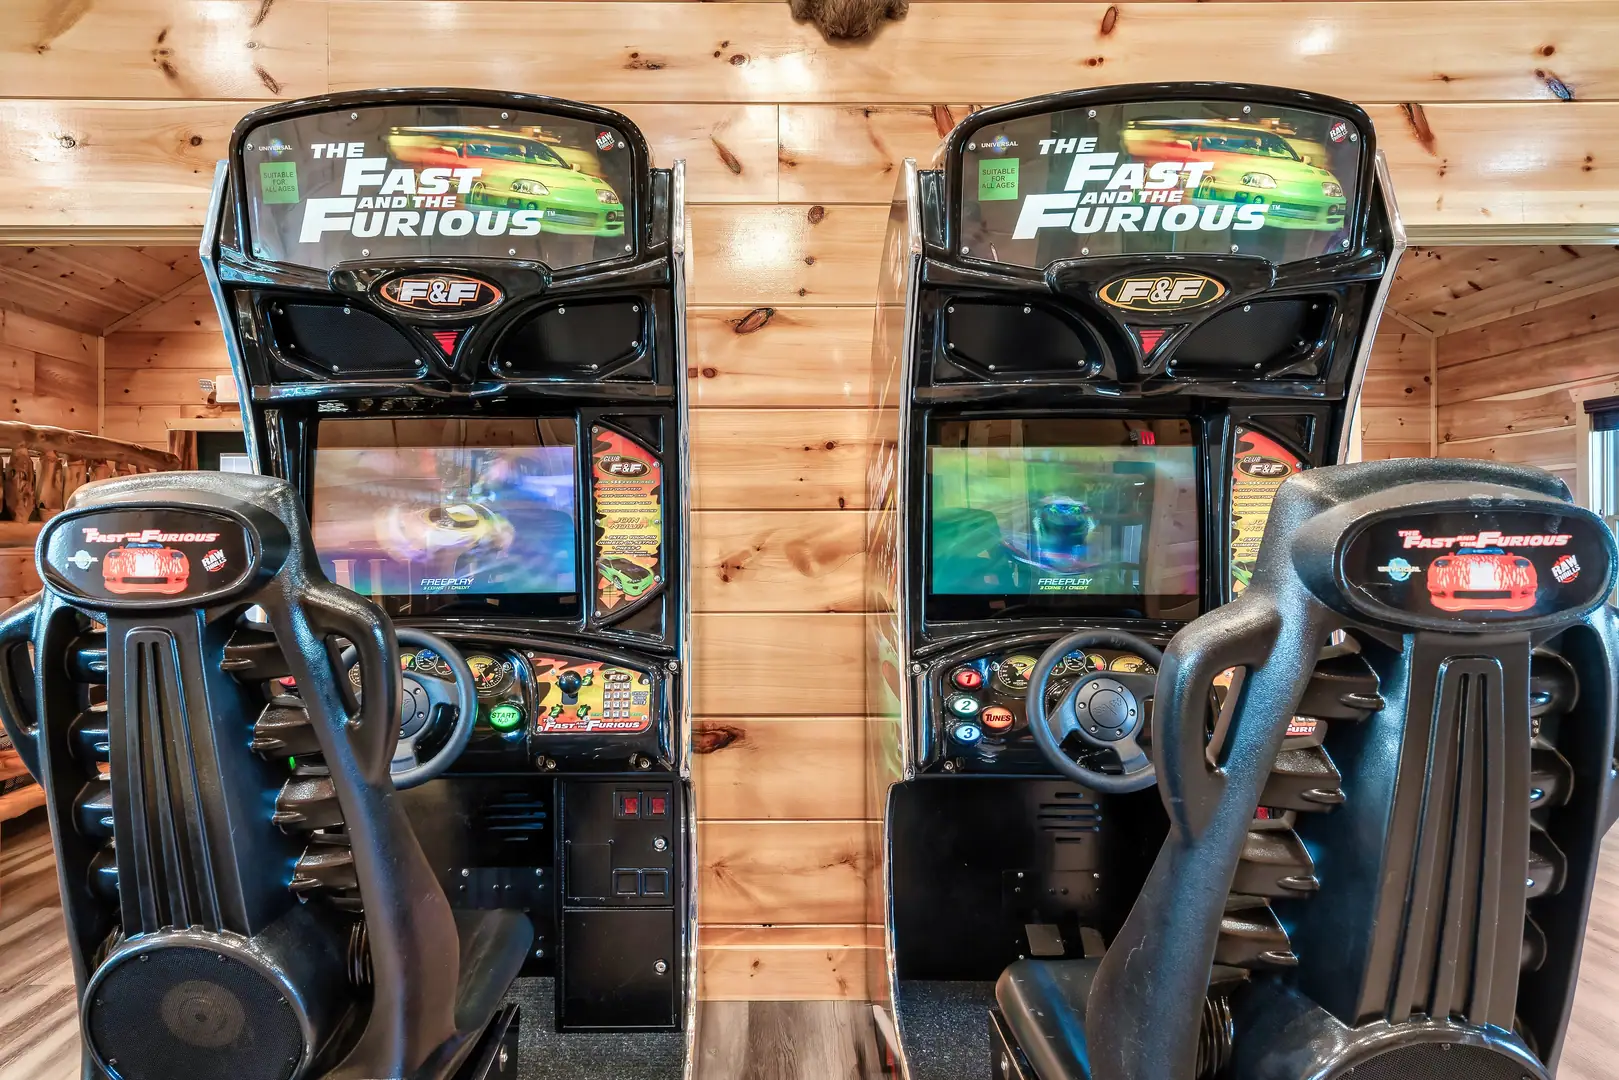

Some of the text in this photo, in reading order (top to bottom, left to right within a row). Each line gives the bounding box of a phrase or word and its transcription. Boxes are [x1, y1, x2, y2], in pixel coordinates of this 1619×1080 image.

[1330, 122, 1346, 138] RAW
[596, 131, 613, 147] RAW
[981, 140, 1019, 148] UNIVERSAL
[1038, 136, 1098, 155] THE
[311, 142, 365, 159] THE
[263, 171, 294, 179] SUITABLE
[340, 158, 483, 196] FAST
[1063, 151, 1214, 191] FAST
[996, 181, 1016, 189] AGES
[356, 195, 457, 209] AND THE
[1078, 190, 1185, 205] AND THE
[298, 197, 545, 243] FURIOUS
[1011, 192, 1270, 240] FURIOUS
[399, 280, 478, 304] F&F
[1118, 279, 1204, 302] F&F
[610, 463, 642, 474] F&F
[1249, 463, 1283, 474] F&F
[86, 532, 125, 542] FAST
[140, 529, 217, 543] FURIOUS
[1403, 535, 1456, 548] FAST
[1476, 531, 1570, 548] FURIOUS
[201, 549, 224, 568] RAW
[1551, 554, 1577, 577] RAW
[421, 578, 474, 586] FREEPLAY
[582, 676, 591, 685] 3
[965, 673, 973, 684] 1
[551, 706, 560, 716] 2
[578, 707, 587, 717] 4
[961, 701, 971, 711] 2
[985, 713, 1011, 722] TUNES
[543, 720, 575, 731] FAST
[585, 720, 640, 731] FURIOUS
[964, 728, 973, 739] 3
